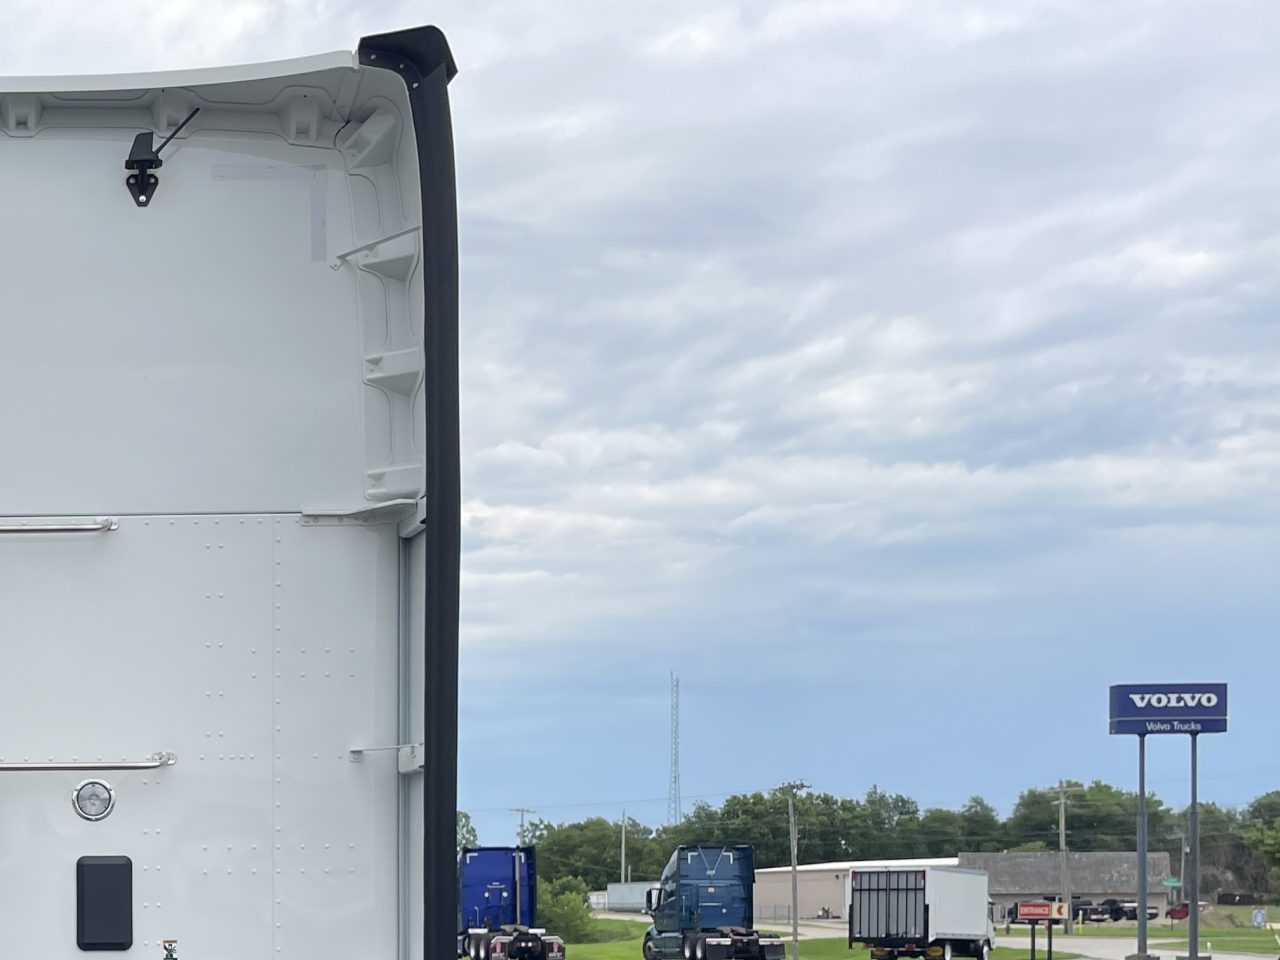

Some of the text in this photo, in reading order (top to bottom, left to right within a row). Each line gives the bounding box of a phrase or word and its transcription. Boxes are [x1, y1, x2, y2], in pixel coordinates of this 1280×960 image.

[1129, 693, 1218, 708] VOLVO
[1146, 721, 1201, 731] Volvo Trucks
